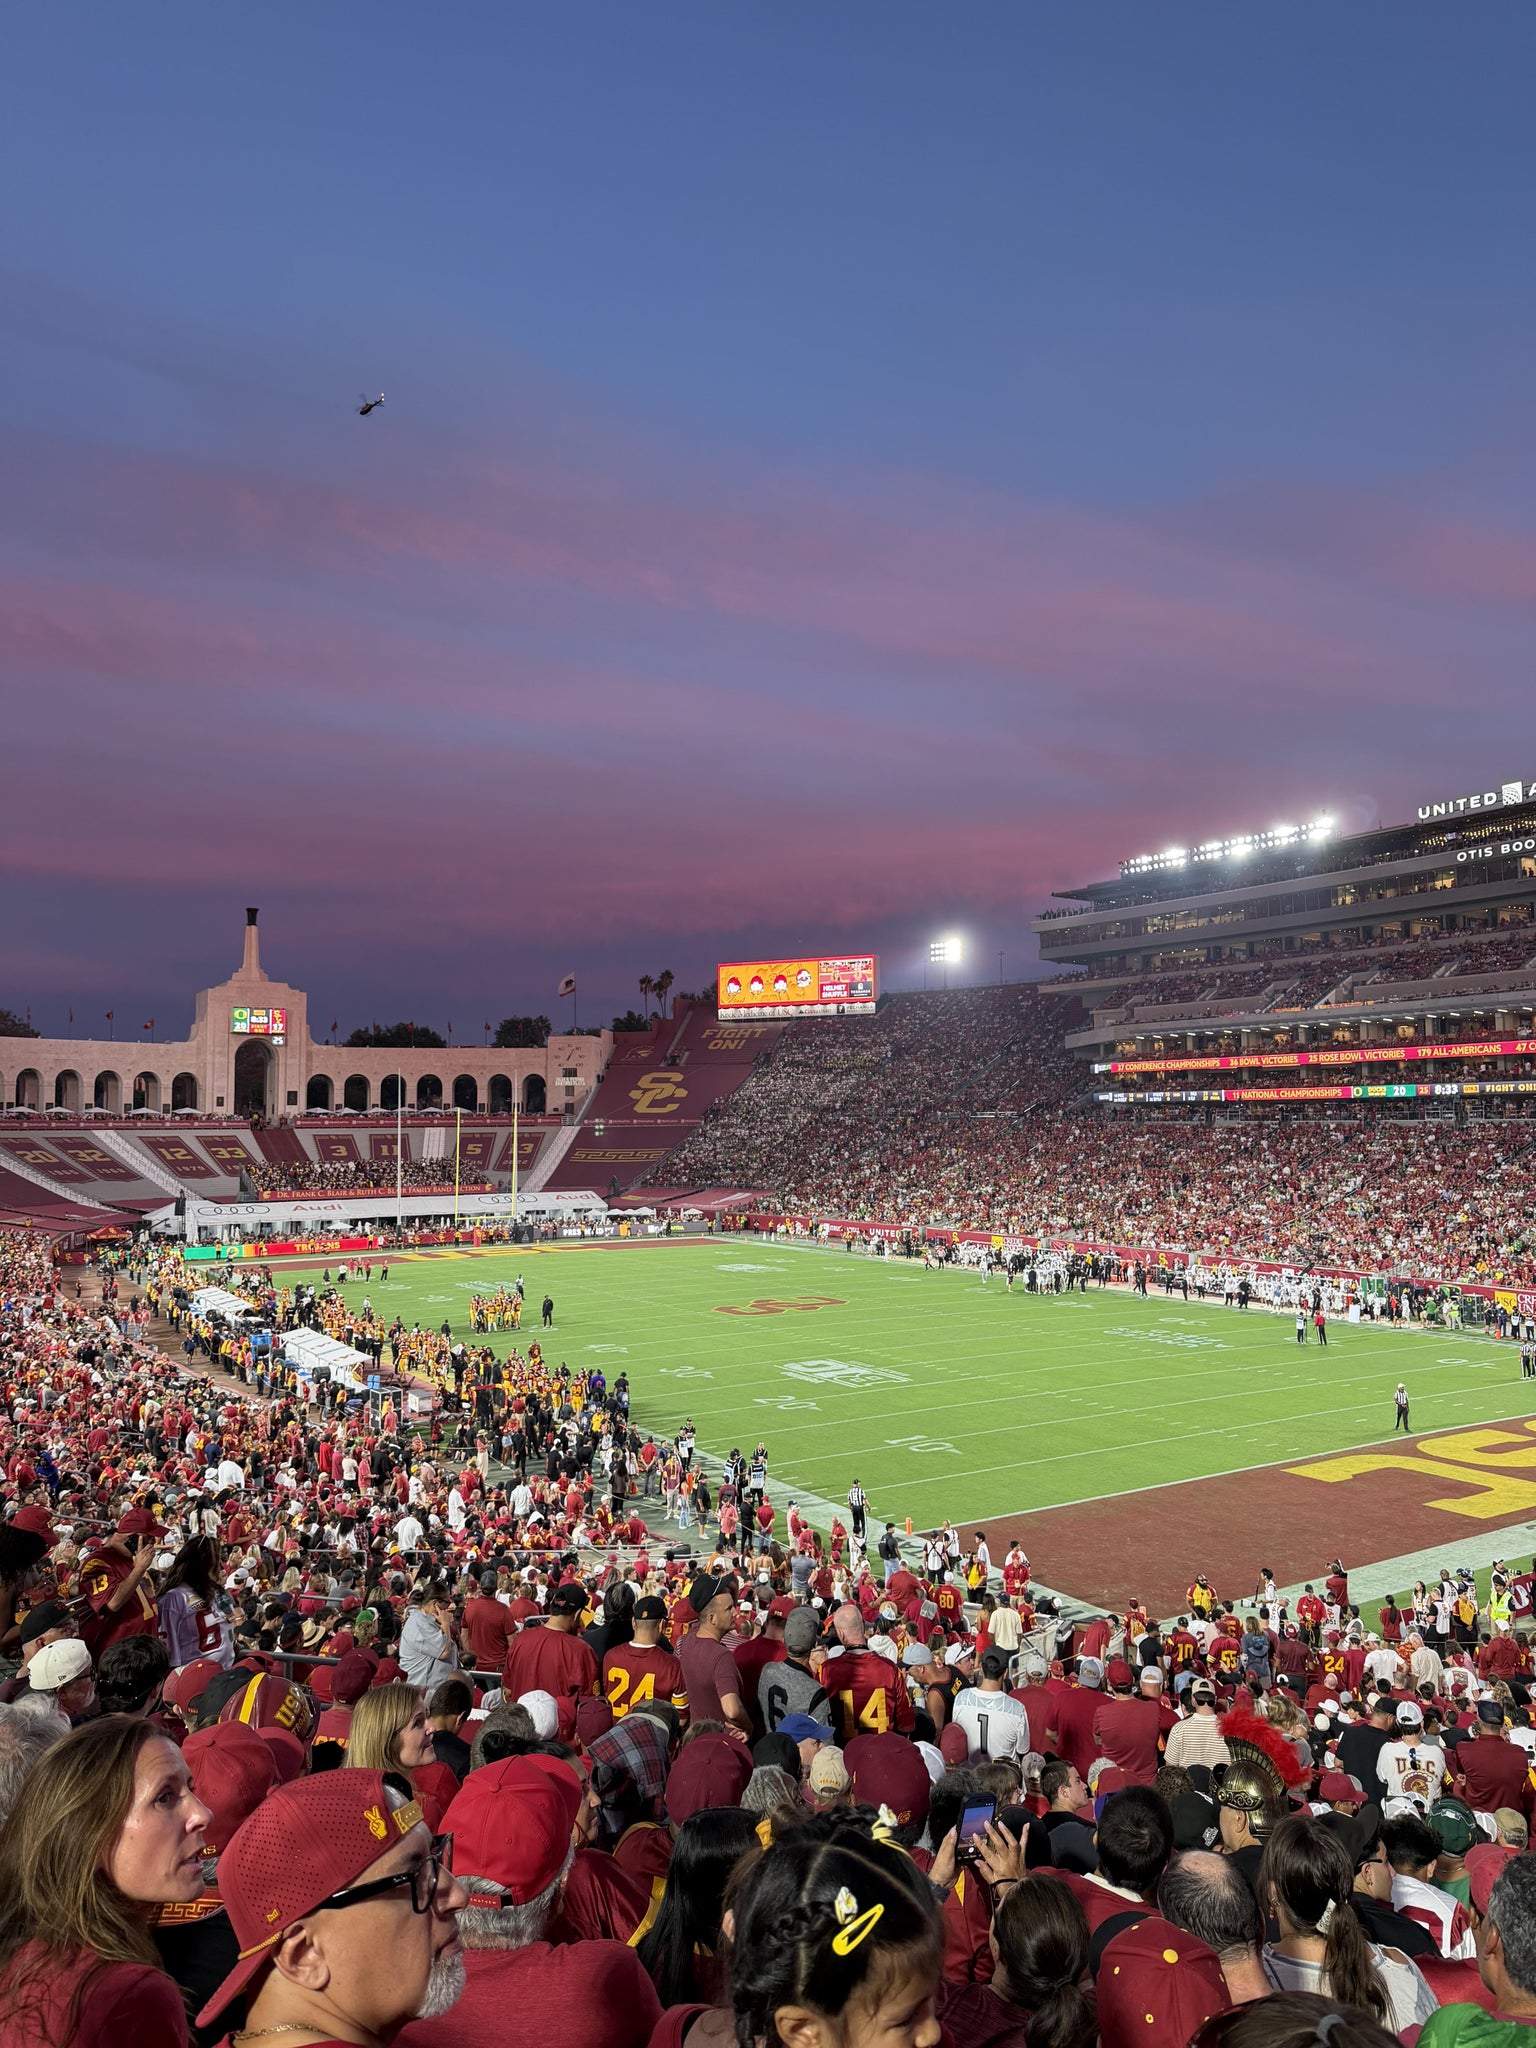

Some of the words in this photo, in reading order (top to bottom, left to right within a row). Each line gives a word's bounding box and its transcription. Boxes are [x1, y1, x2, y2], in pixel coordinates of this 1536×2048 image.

[1418, 792, 1497, 819] UNITED
[1456, 846, 1493, 862] OTIS
[822, 984, 847, 992] HELMET
[701, 1028, 768, 1039] FIGHT
[708, 1039, 746, 1050] ON!
[1515, 1043, 1527, 1052] 47
[1340, 1052, 1363, 1060] BOWL
[1364, 1050, 1406, 1059] VICTORIES
[1417, 1049, 1432, 1057] 179
[1433, 1045, 1502, 1056] ALL-AMERICANS
[1125, 1062, 1166, 1070] CONFERENCE
[1166, 1060, 1220, 1069] CHAMPIONSHIPS
[1240, 1058, 1260, 1066] BOWL
[1261, 1055, 1298, 1064] VICTORIES
[1241, 1090, 1279, 1099] NATIONAL
[1280, 1089, 1342, 1098] CHAMPIONSHIPS
[1393, 1086, 1406, 1096] 20
[1434, 1084, 1458, 1095] 8:33
[1485, 1084, 1515, 1093] FIGHT
[158, 1147, 194, 1160] 12
[210, 1147, 248, 1159] 33
[330, 1145, 348, 1156] 3
[466, 1143, 483, 1155] 5
[67, 1149, 112, 1162] 32
[292, 1190, 316, 1198] FRANK
[556, 1193, 595, 1201] Audi
[292, 1203, 343, 1212] Audi
[393, 1244, 607, 1261] USC
[753, 1395, 815, 1411] 20
[884, 1435, 955, 1453] 10
[90, 1574, 109, 1596] 13
[939, 1594, 955, 1609] 80
[1177, 1644, 1194, 1662] 10
[1221, 1650, 1238, 1669] 55
[1324, 1655, 1345, 1673] 24
[607, 1666, 656, 1718] 24
[768, 1684, 789, 1732] 6
[839, 1688, 890, 1738] 14
[977, 1713, 990, 1755] 1
